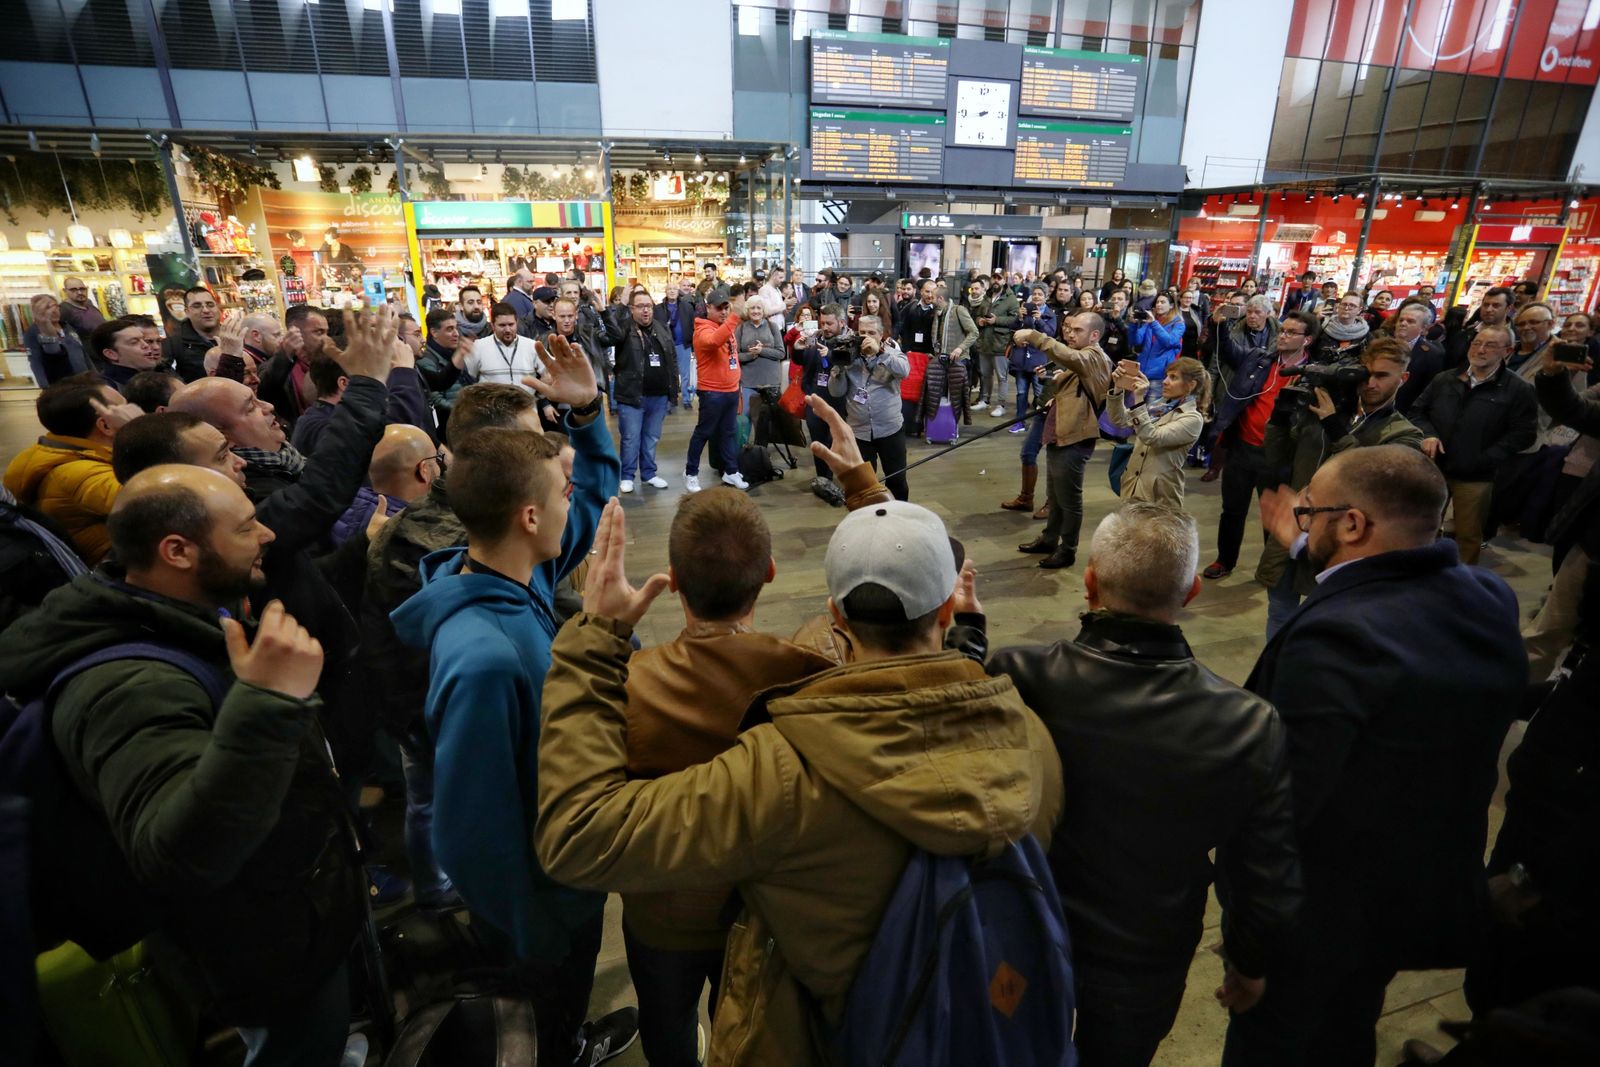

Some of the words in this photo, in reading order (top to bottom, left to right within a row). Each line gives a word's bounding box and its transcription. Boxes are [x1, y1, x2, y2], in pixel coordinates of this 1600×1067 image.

[1558, 56, 1592, 68] vodafone
[980, 87, 990, 96] 12
[961, 109, 968, 118] 9
[997, 111, 1004, 119] 3
[978, 132, 985, 140] 6
[664, 208, 719, 231] discover
